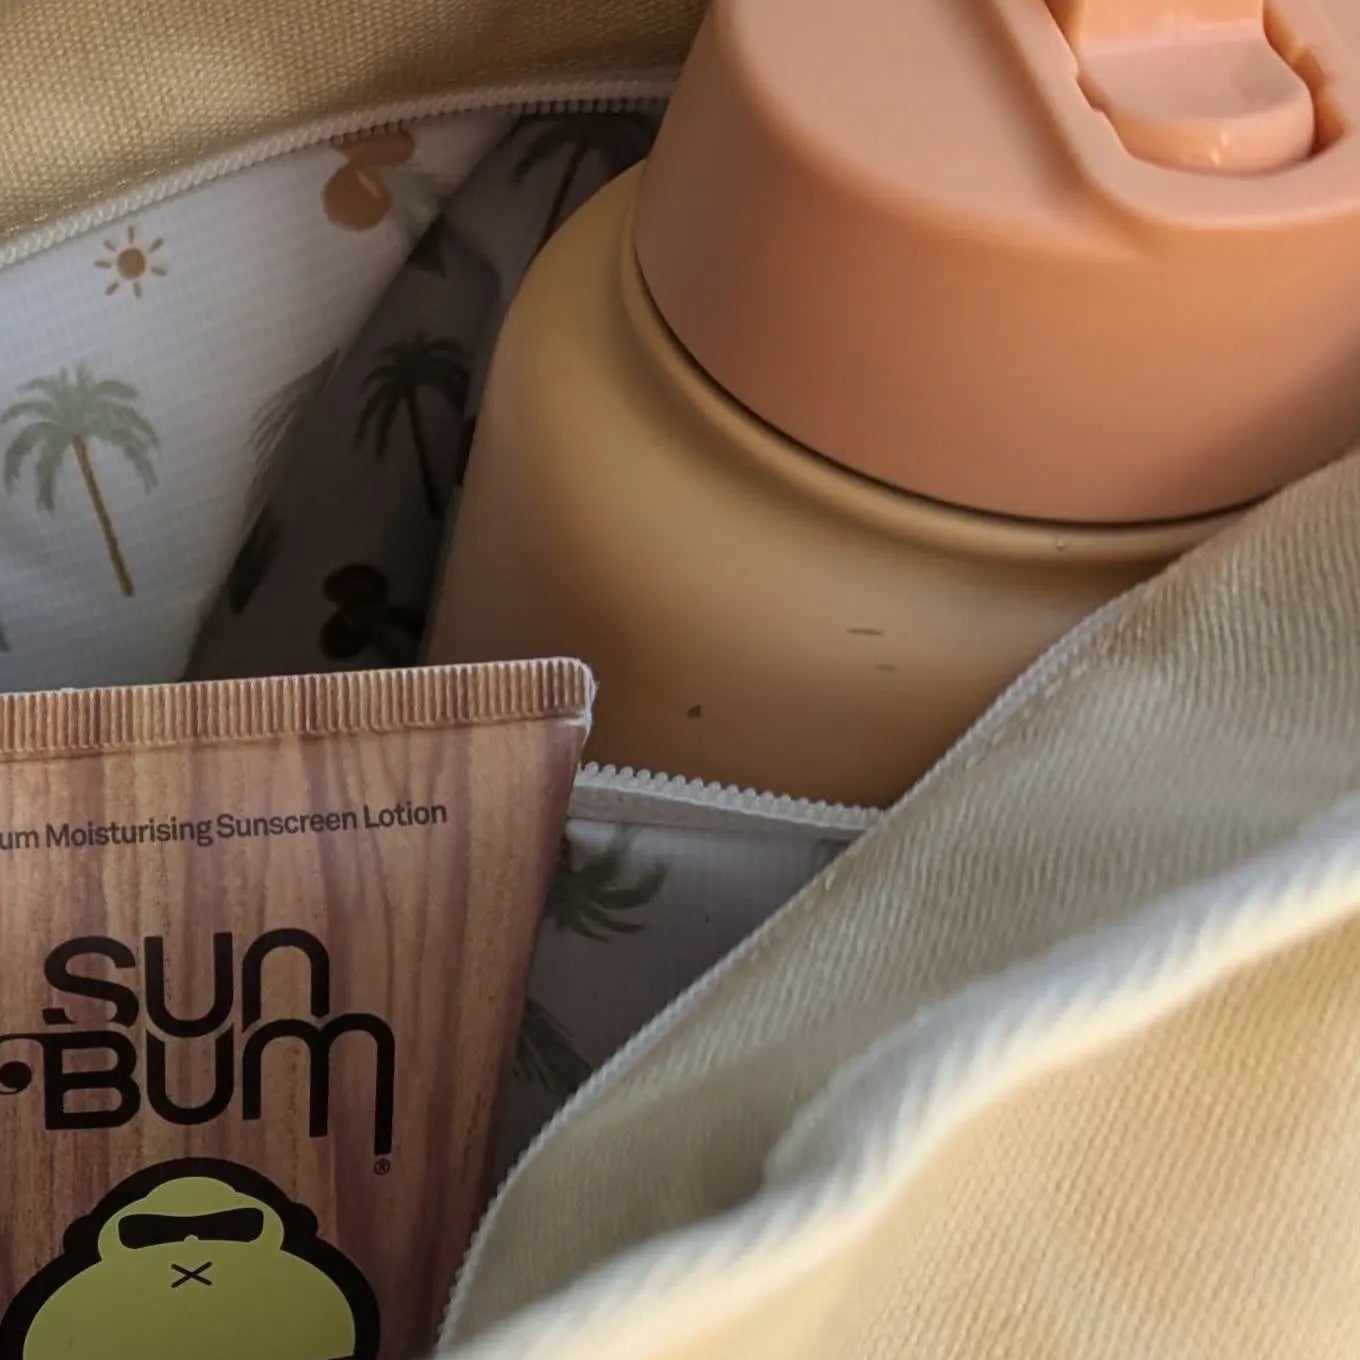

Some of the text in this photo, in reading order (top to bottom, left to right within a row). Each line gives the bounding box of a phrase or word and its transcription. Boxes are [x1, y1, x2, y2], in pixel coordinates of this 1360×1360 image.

[45, 815, 213, 849] Moisturising
[216, 811, 358, 837] Sunscreen
[364, 802, 448, 829] Lotion
